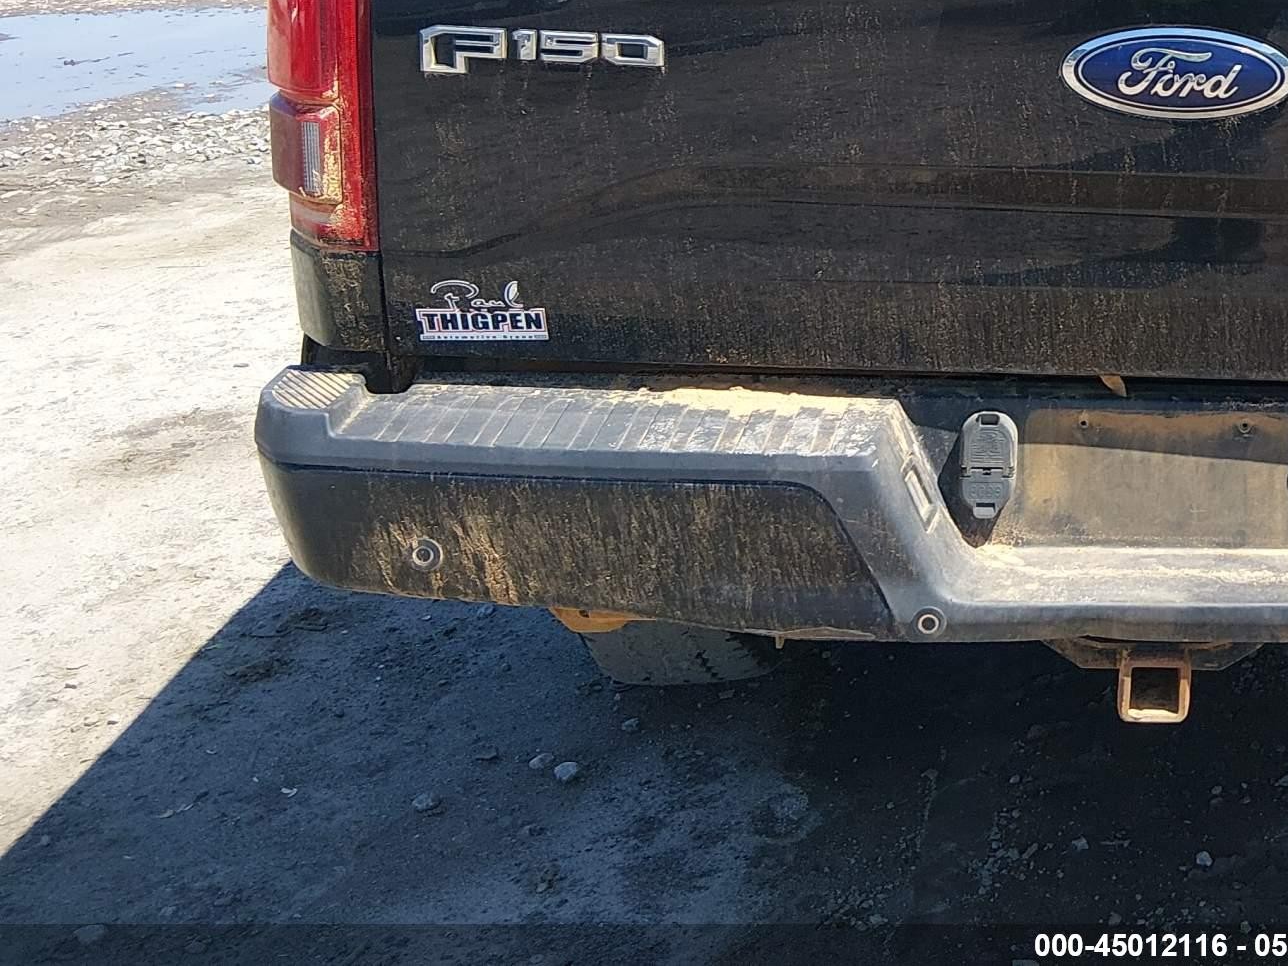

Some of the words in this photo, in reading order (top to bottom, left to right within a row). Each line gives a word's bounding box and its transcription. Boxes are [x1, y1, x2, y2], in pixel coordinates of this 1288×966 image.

[420, 24, 666, 75] F150
[1117, 46, 1243, 100] Ford
[429, 278, 525, 310] Paul
[420, 311, 545, 332] THIGPEN
